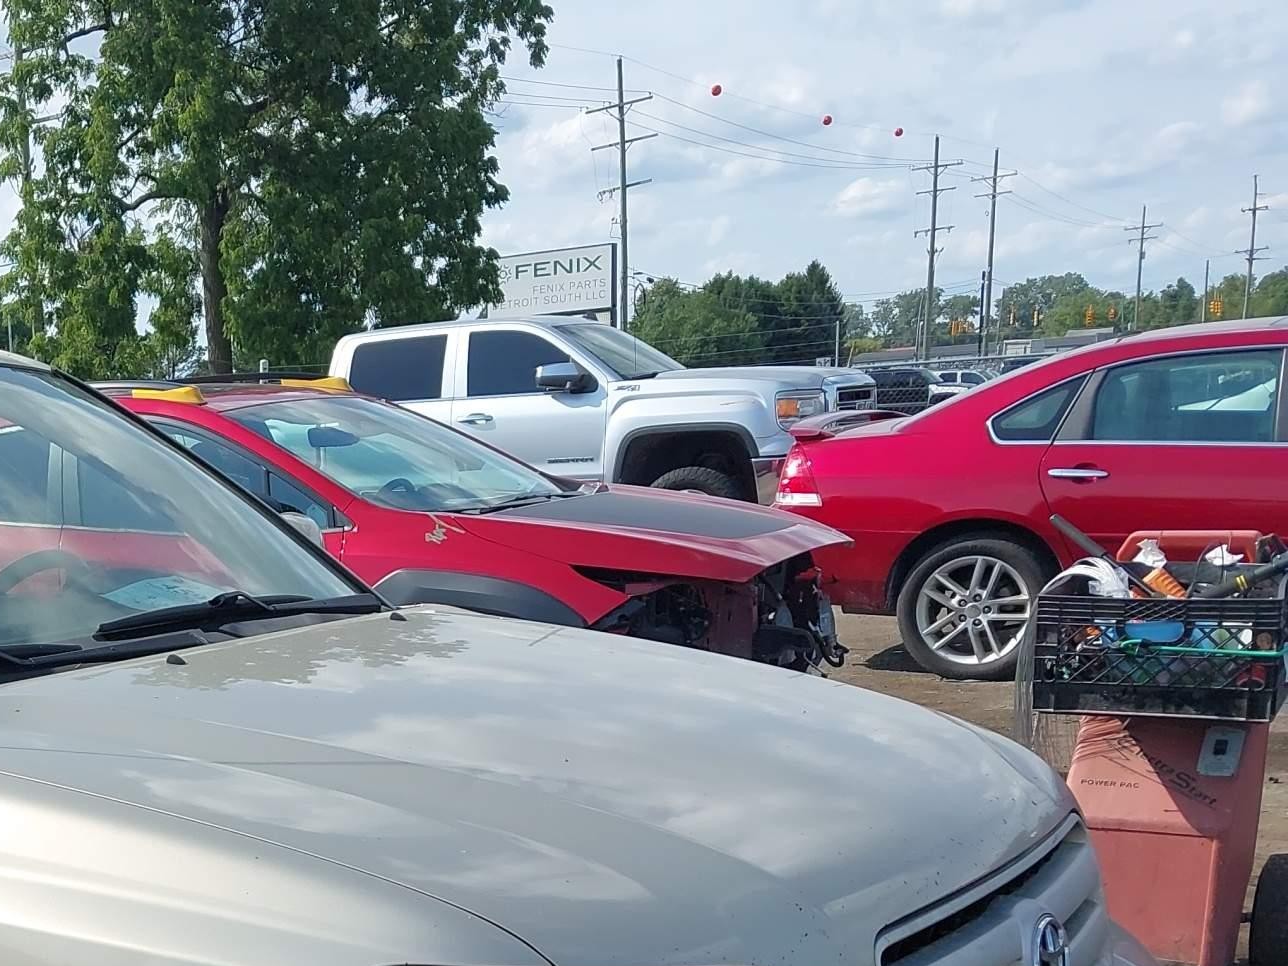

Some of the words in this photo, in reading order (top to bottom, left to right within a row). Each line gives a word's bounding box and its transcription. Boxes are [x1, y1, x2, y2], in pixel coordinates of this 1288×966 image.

[515, 255, 602, 279] FENIX
[532, 282, 565, 295] FENIX
[569, 278, 607, 290] PARTS
[543, 293, 581, 305] SOUTH
[586, 290, 607, 301] LLC
[1080, 778, 1116, 787] POWER
[1119, 780, 1140, 789] PAC
